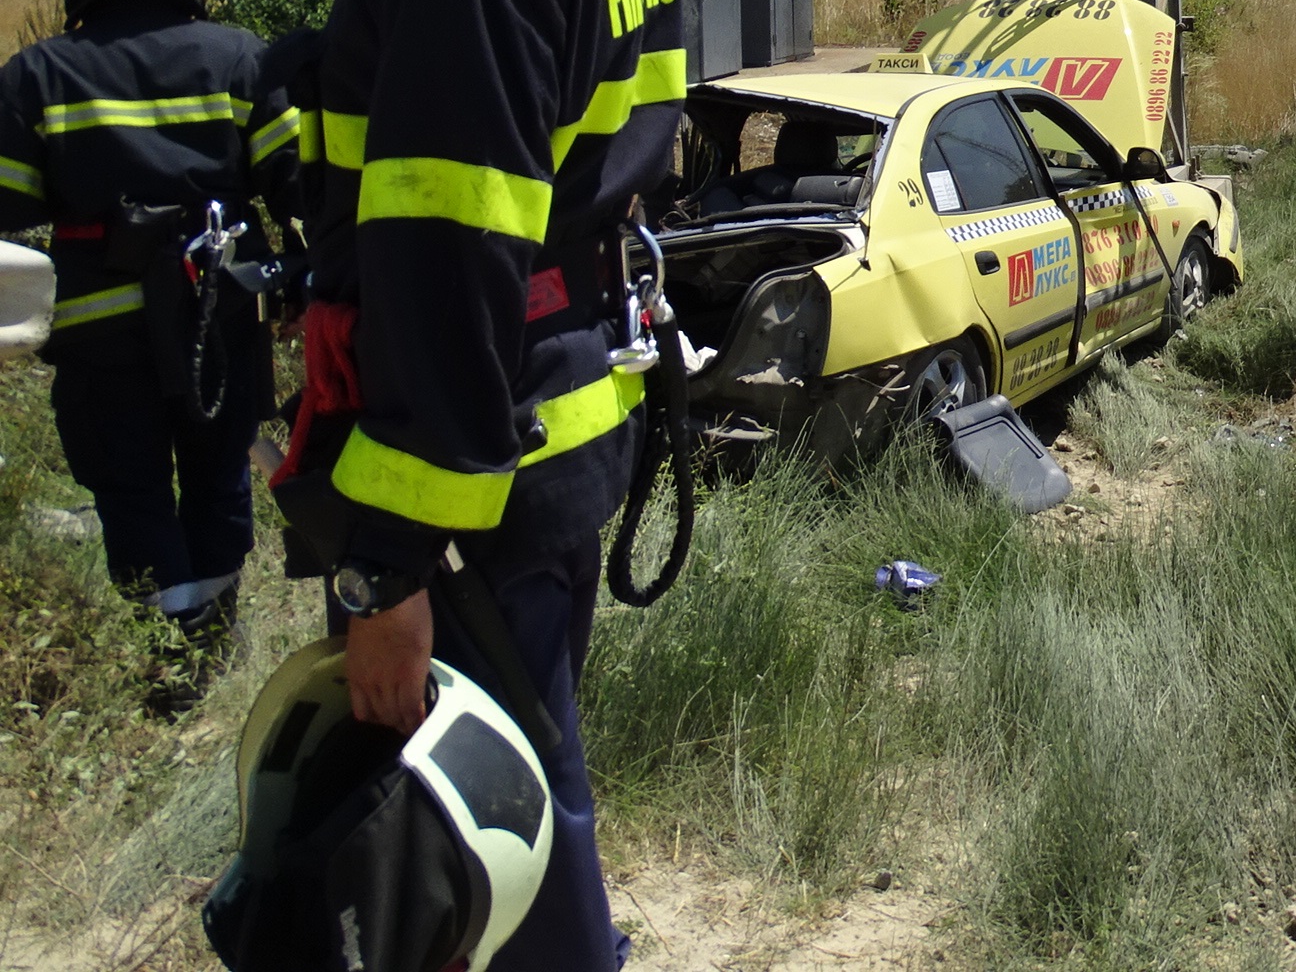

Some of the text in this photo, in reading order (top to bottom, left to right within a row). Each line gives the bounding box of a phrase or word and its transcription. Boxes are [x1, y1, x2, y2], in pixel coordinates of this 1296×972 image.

[1073, 0, 1116, 20] 88
[878, 58, 919, 69] ТАКСИ
[1145, 32, 1173, 122] 0896 86 22 22
[898, 178, 924, 207] 29
[1033, 236, 1071, 271] МЕГА
[1034, 264, 1069, 297] ЛУКС
